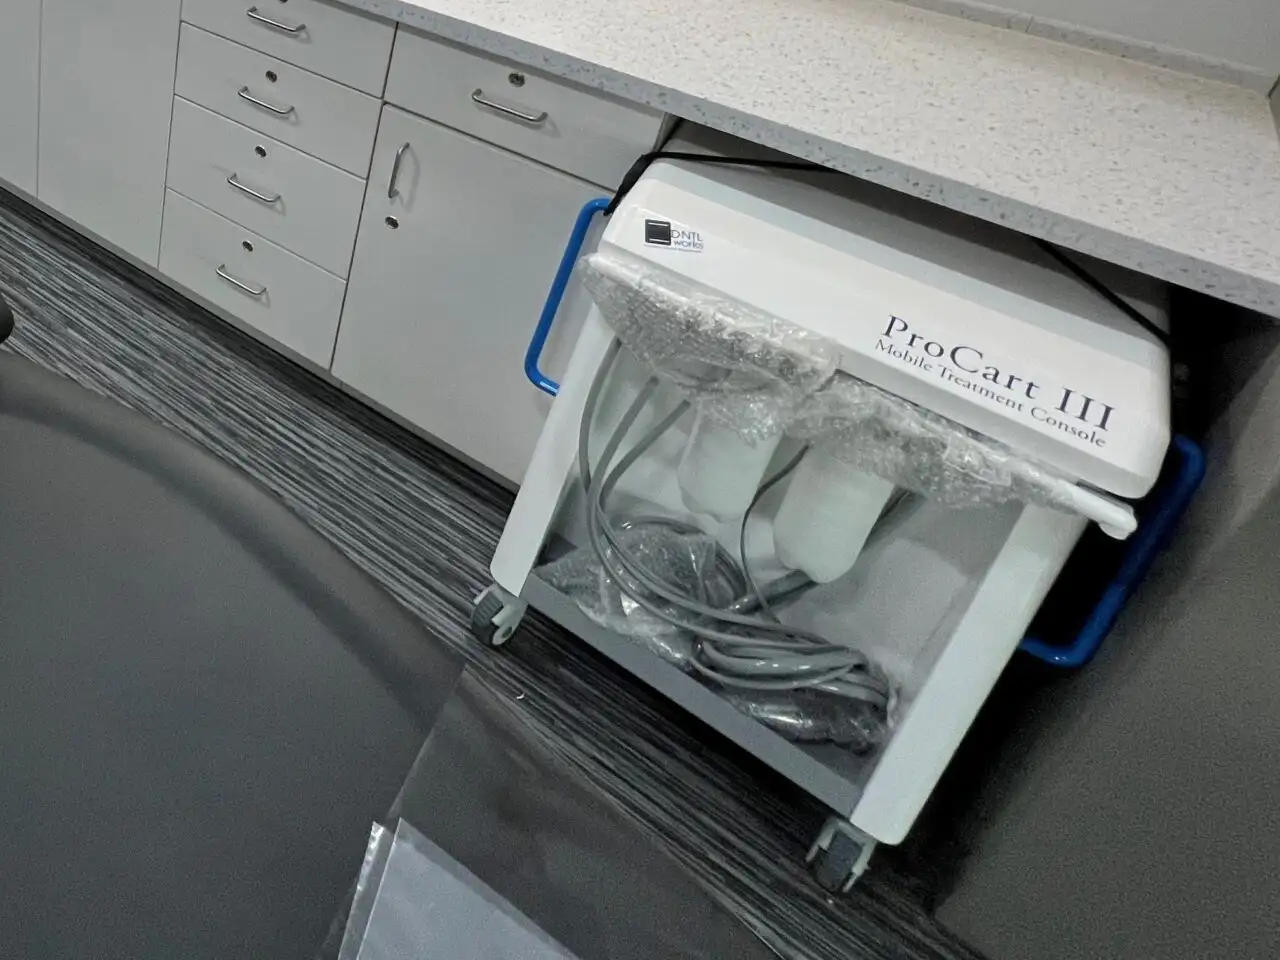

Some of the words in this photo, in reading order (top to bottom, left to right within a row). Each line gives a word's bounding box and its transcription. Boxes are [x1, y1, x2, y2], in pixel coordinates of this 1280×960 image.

[670, 229, 703, 242] DNTL
[875, 338, 933, 372] Mobile
[938, 363, 1024, 413] Treatment
[1030, 406, 1107, 448] Console
[880, 314, 1040, 400] ProCart
[1054, 386, 1116, 432] III
